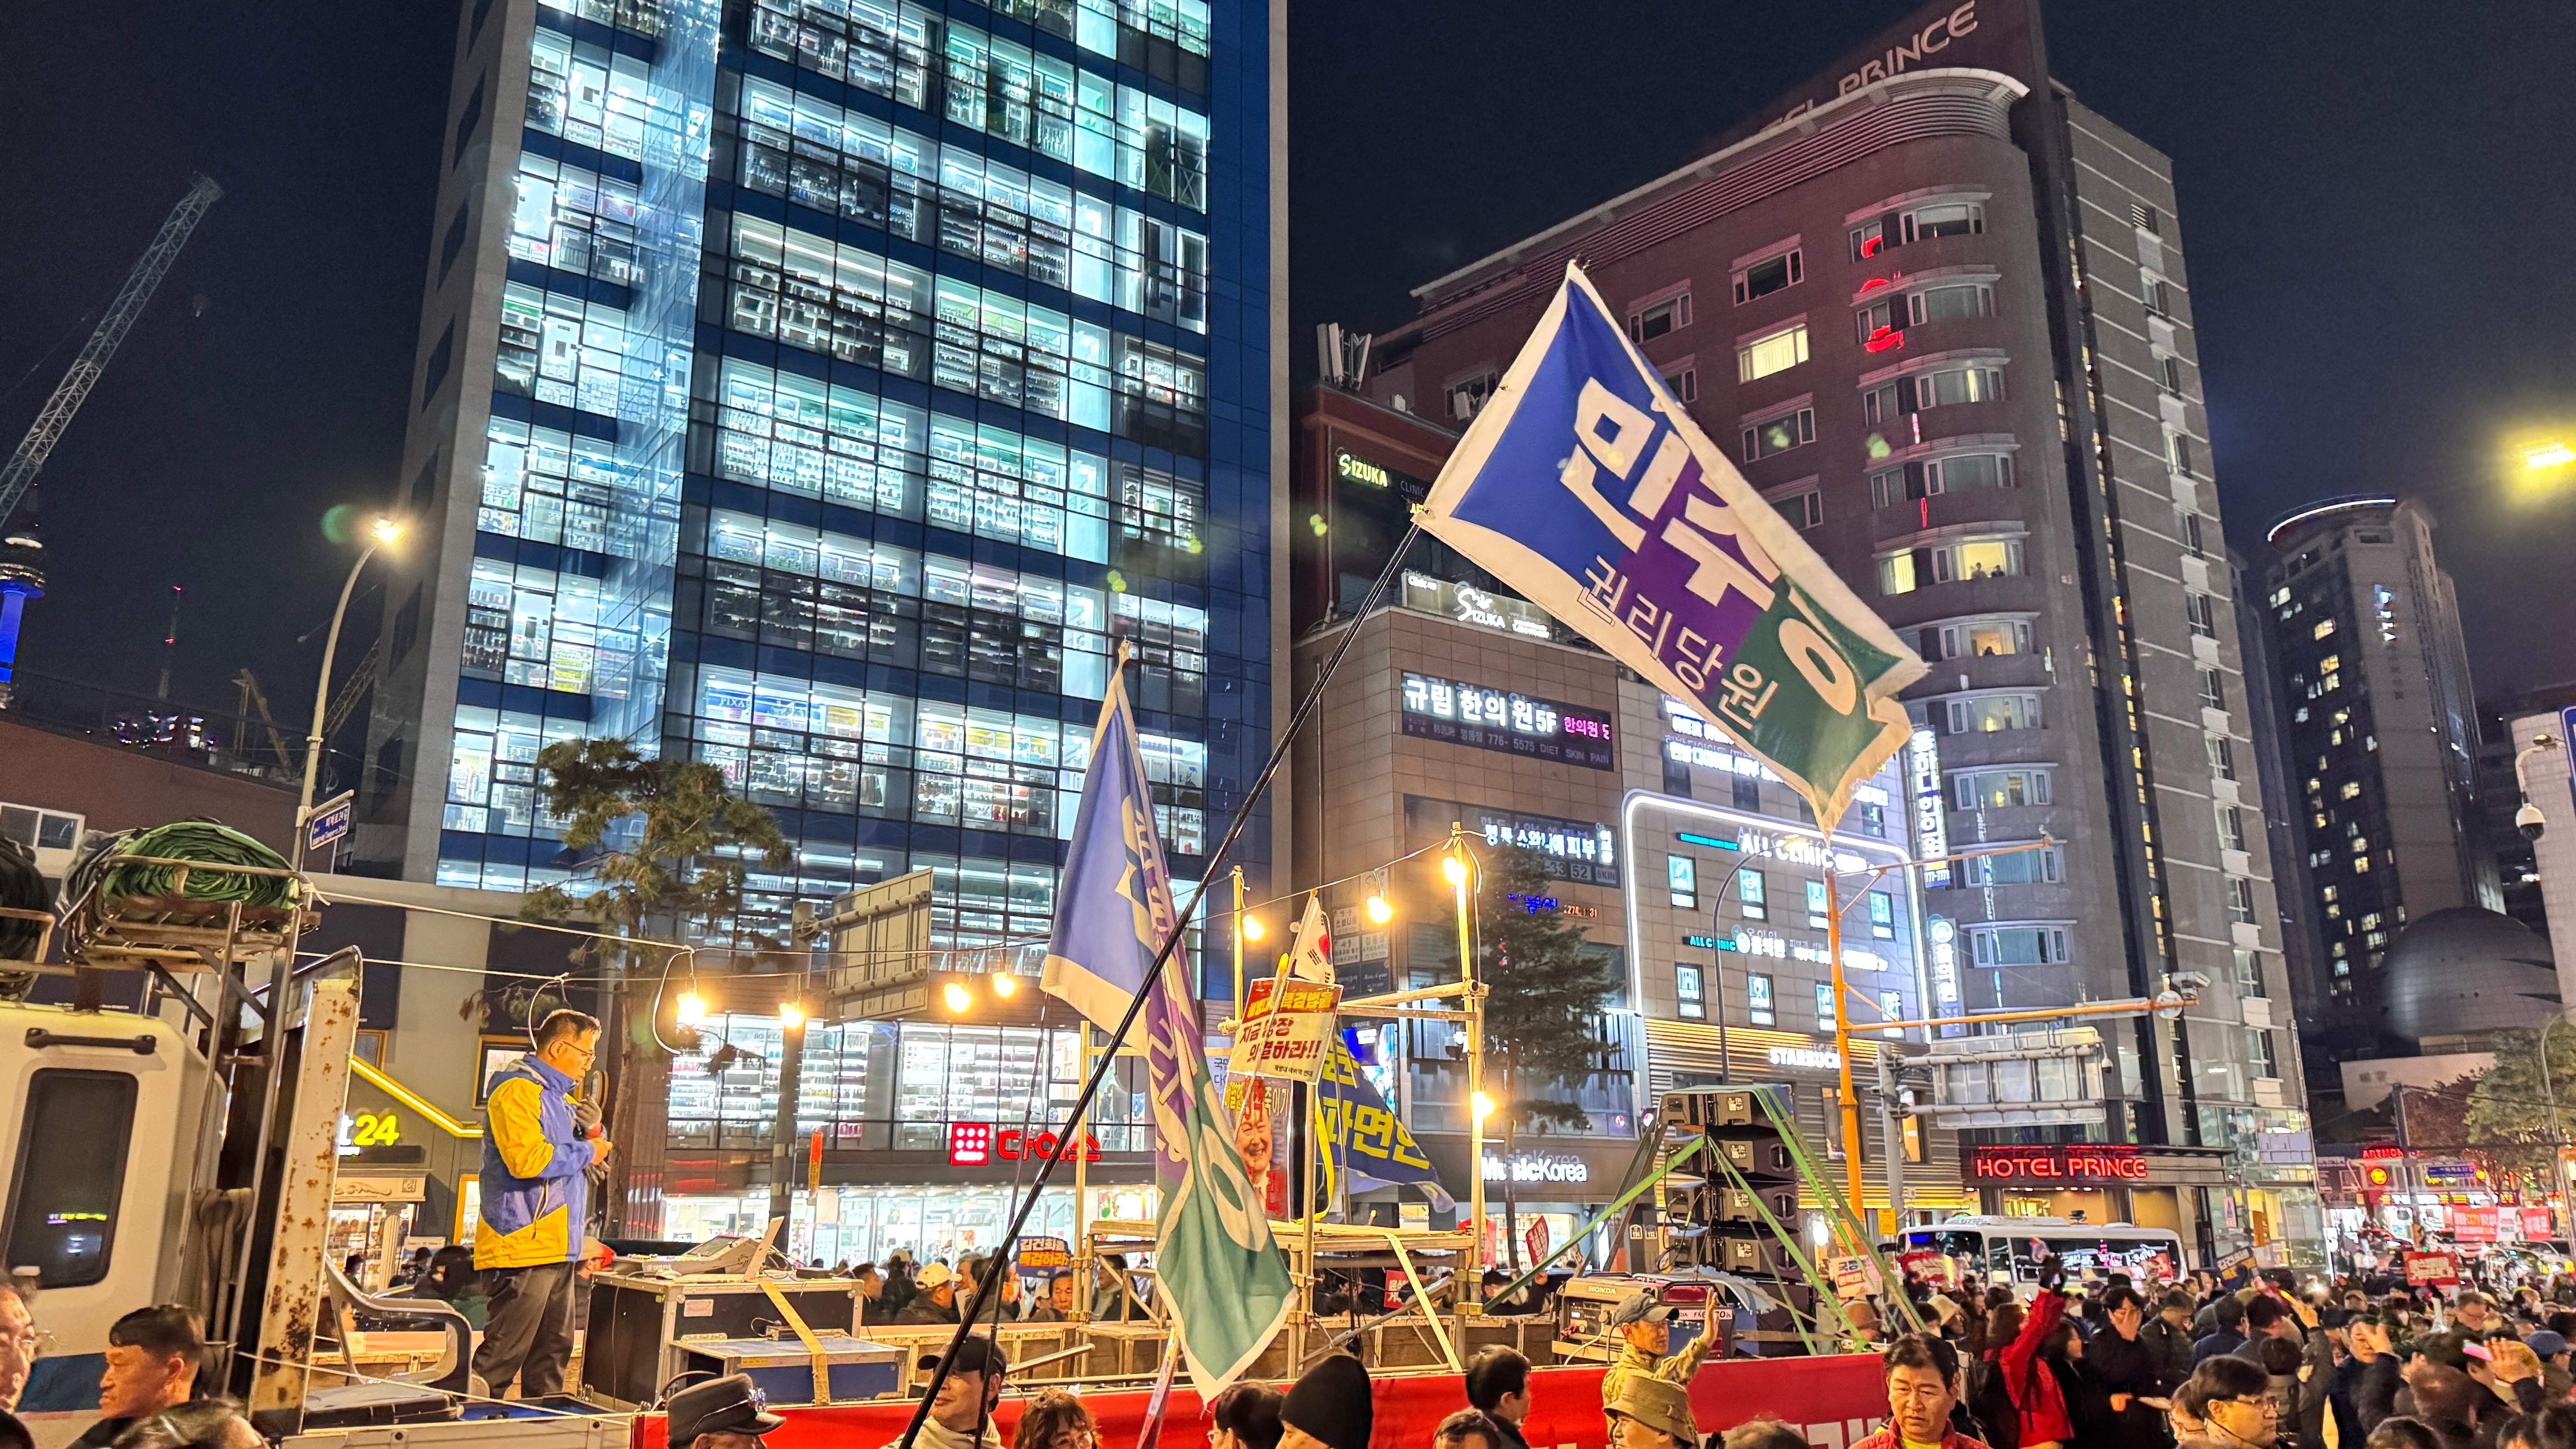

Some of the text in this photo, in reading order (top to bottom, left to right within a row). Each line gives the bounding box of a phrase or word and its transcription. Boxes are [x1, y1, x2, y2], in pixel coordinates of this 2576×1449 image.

[1838, 0, 1978, 96] PRINCE
[1338, 453, 1388, 488] SIZUKA
[1577, 555, 1778, 731] 권리당원
[1405, 679, 1452, 716] 규림
[1706, 937, 1737, 952] CINIC
[1977, 1157, 2148, 1178] HOTEL PRINCE
[1588, 1285, 1617, 1295] HONDA
